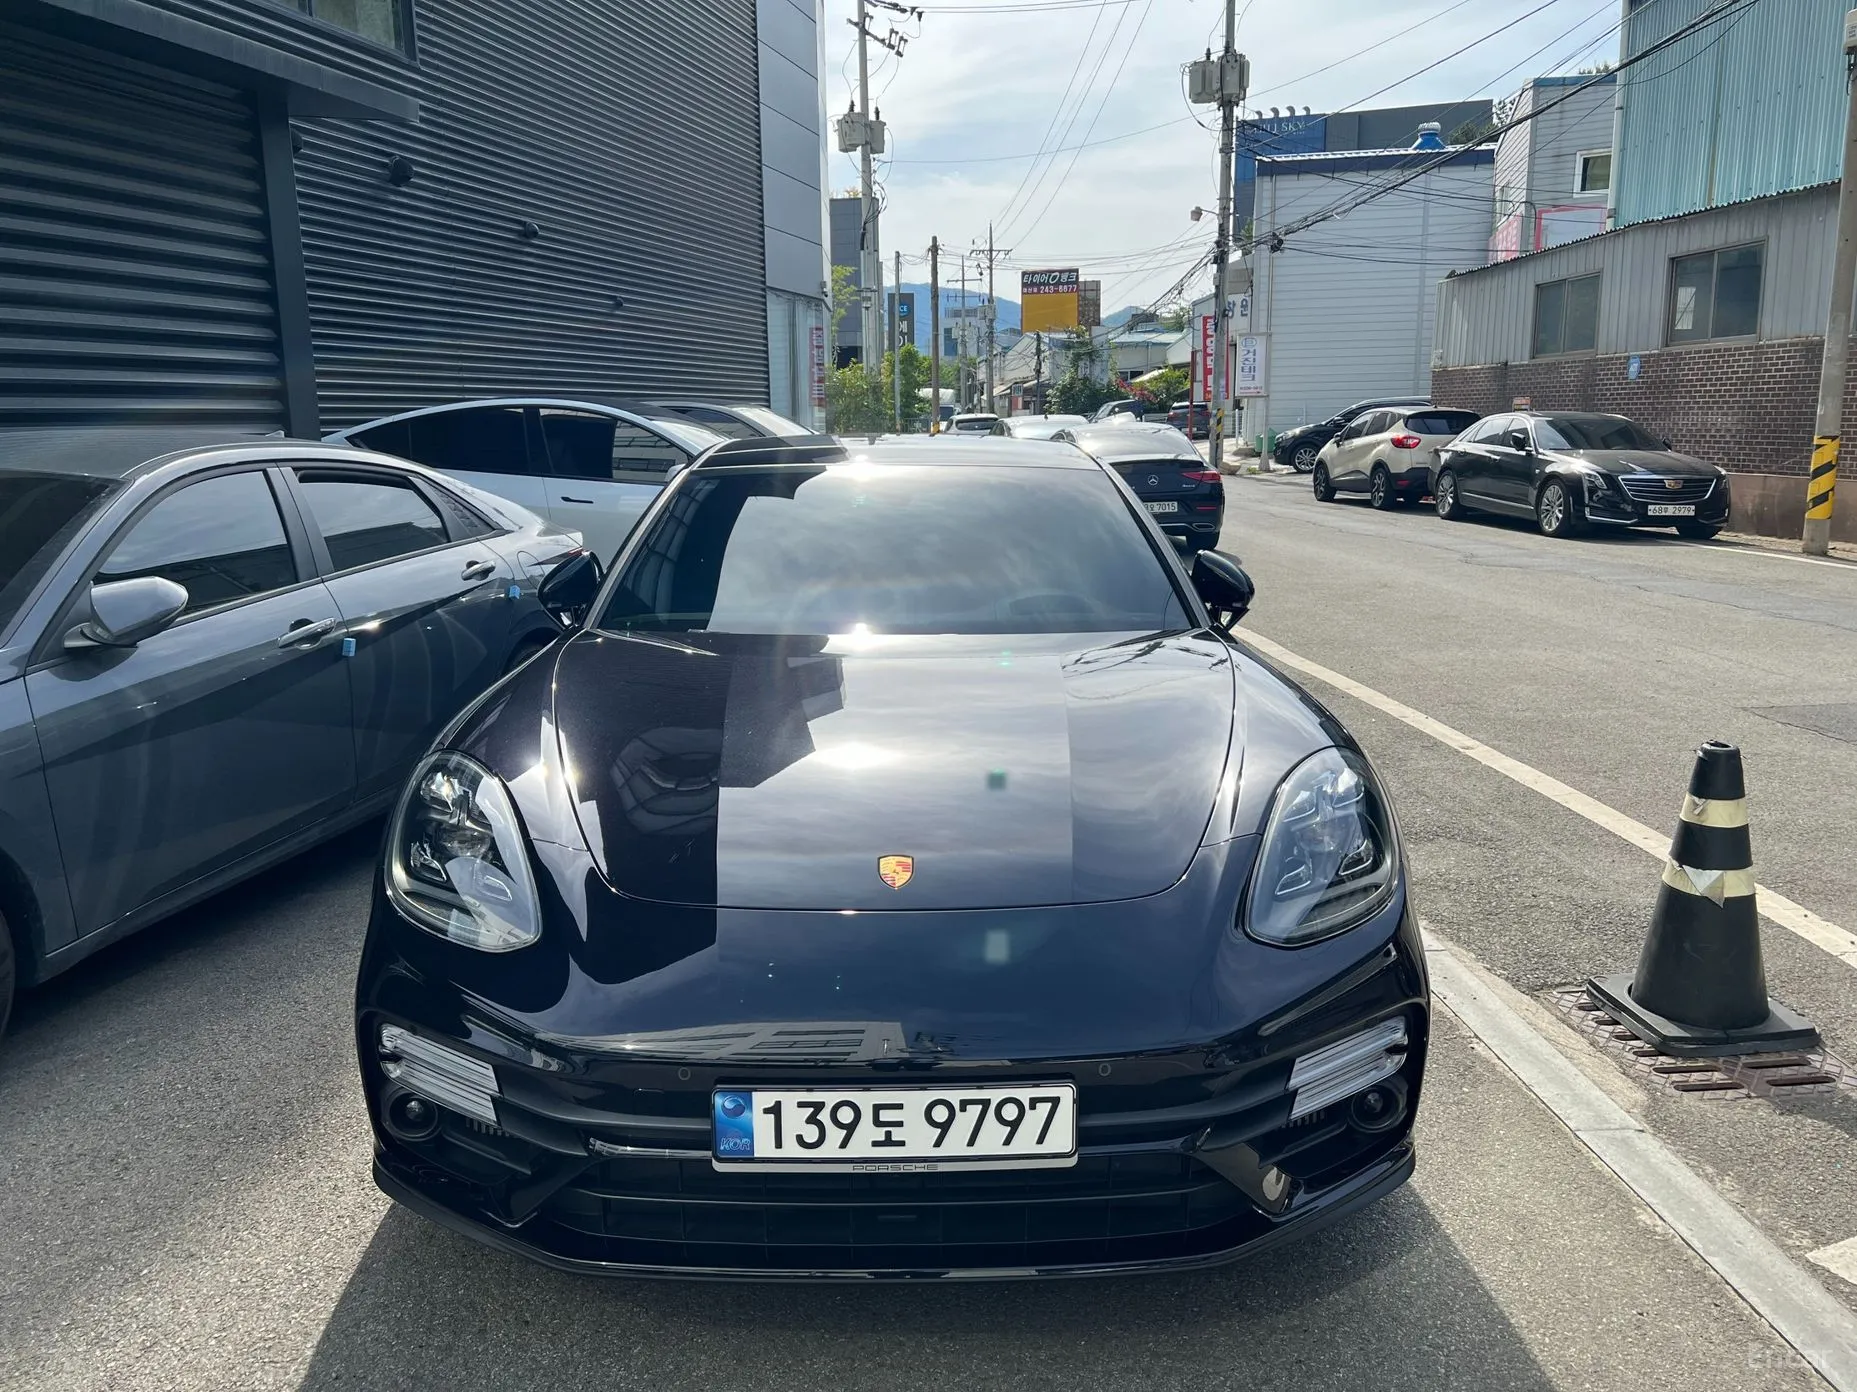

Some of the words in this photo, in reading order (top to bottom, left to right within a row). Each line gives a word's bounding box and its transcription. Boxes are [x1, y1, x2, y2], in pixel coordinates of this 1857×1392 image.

[1281, 121, 1306, 132] SKY
[1156, 502, 1176, 511] 7015
[1672, 506, 1692, 514] 2979
[762, 1100, 906, 1150] 139도
[924, 1096, 1061, 1147] 9797
[720, 1137, 751, 1151] KOR
